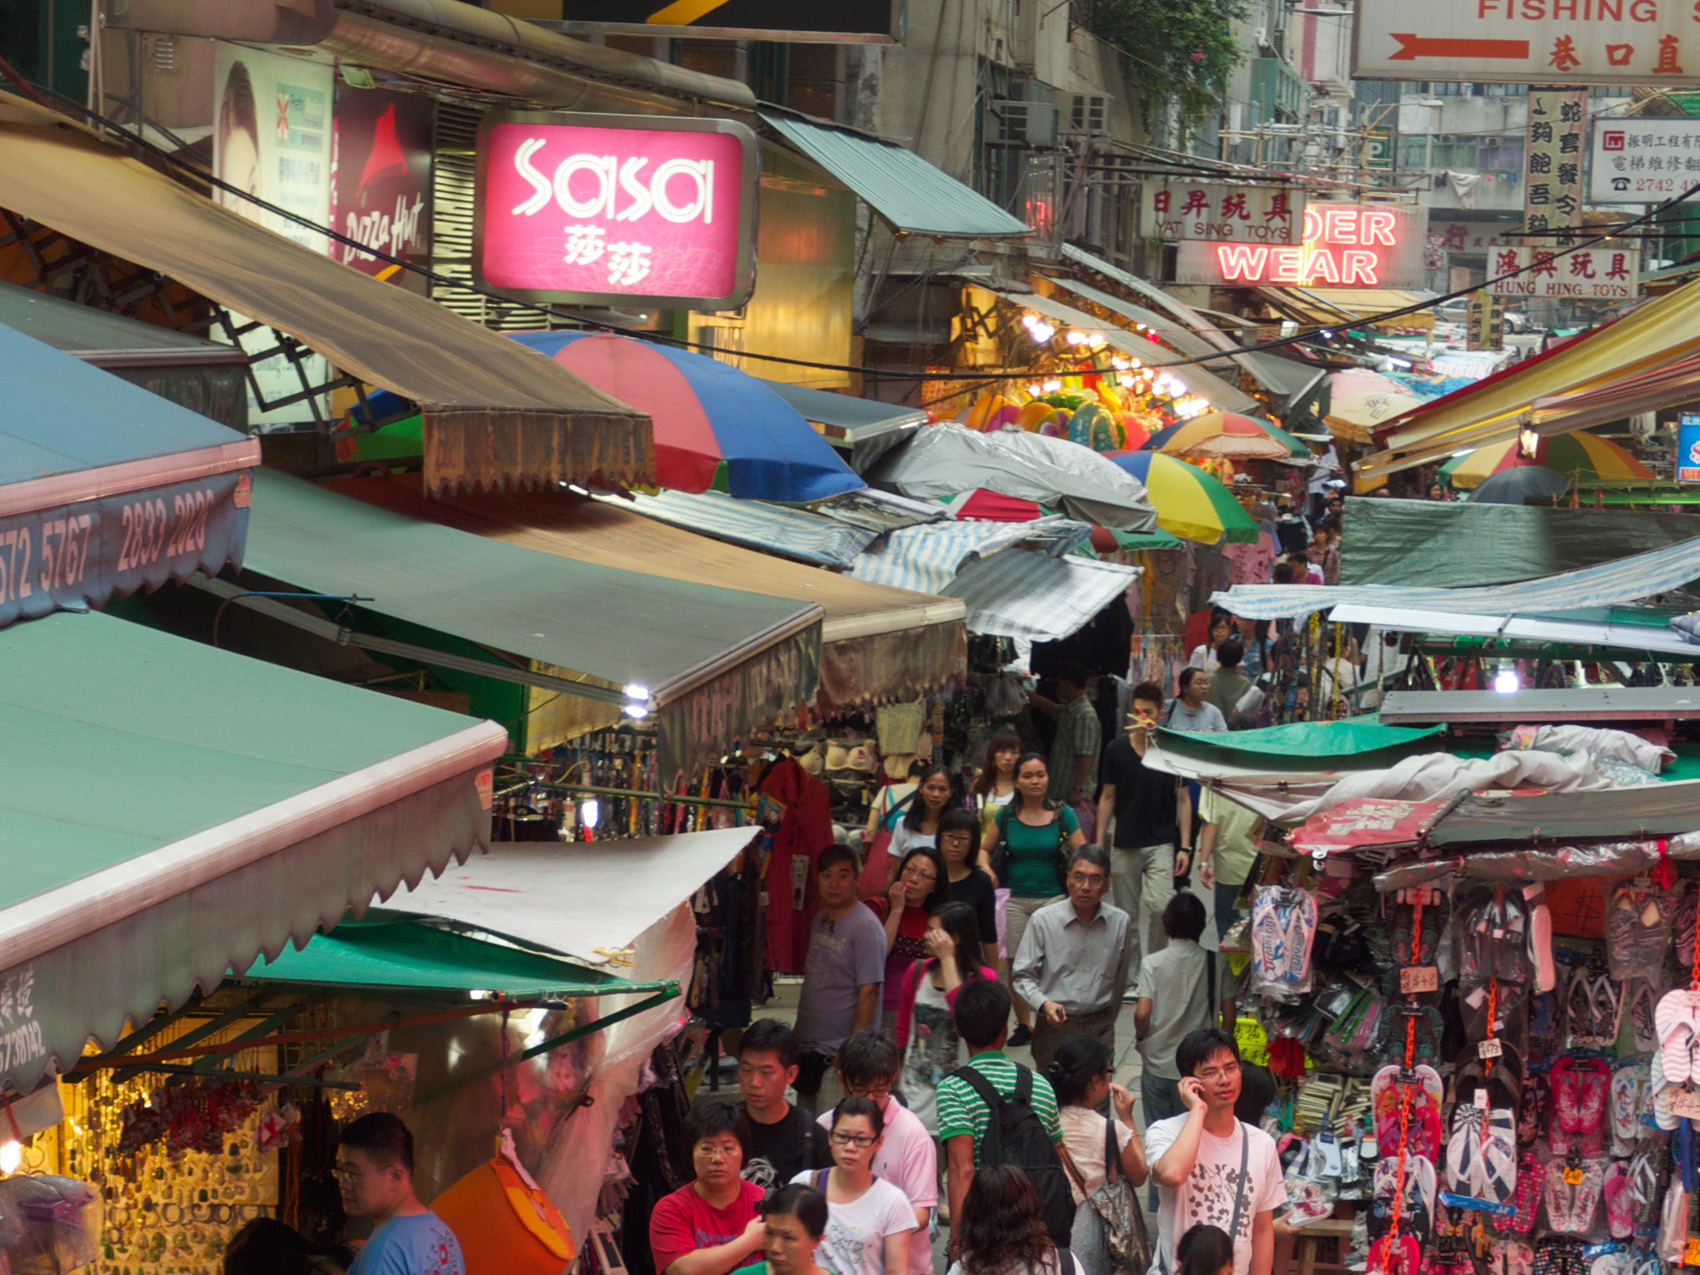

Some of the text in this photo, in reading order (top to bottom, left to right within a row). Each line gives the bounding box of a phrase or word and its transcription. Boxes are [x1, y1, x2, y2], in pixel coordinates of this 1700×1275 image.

[1478, 0, 1657, 22] FISHING
[1548, 34, 1684, 74] 巷口直
[1636, 178, 1674, 192] 2742
[1153, 189, 1293, 223] 日昇玩具
[344, 210, 390, 265] Pizza
[391, 192, 425, 258] Hut
[1155, 220, 1290, 240] YAT SING TOYS
[564, 224, 652, 286] 莎莎
[1217, 246, 1379, 285] WEAR
[1494, 281, 1628, 297] HUNG HING TOYS
[40, 514, 92, 592] 5767
[117, 498, 167, 572] 2833
